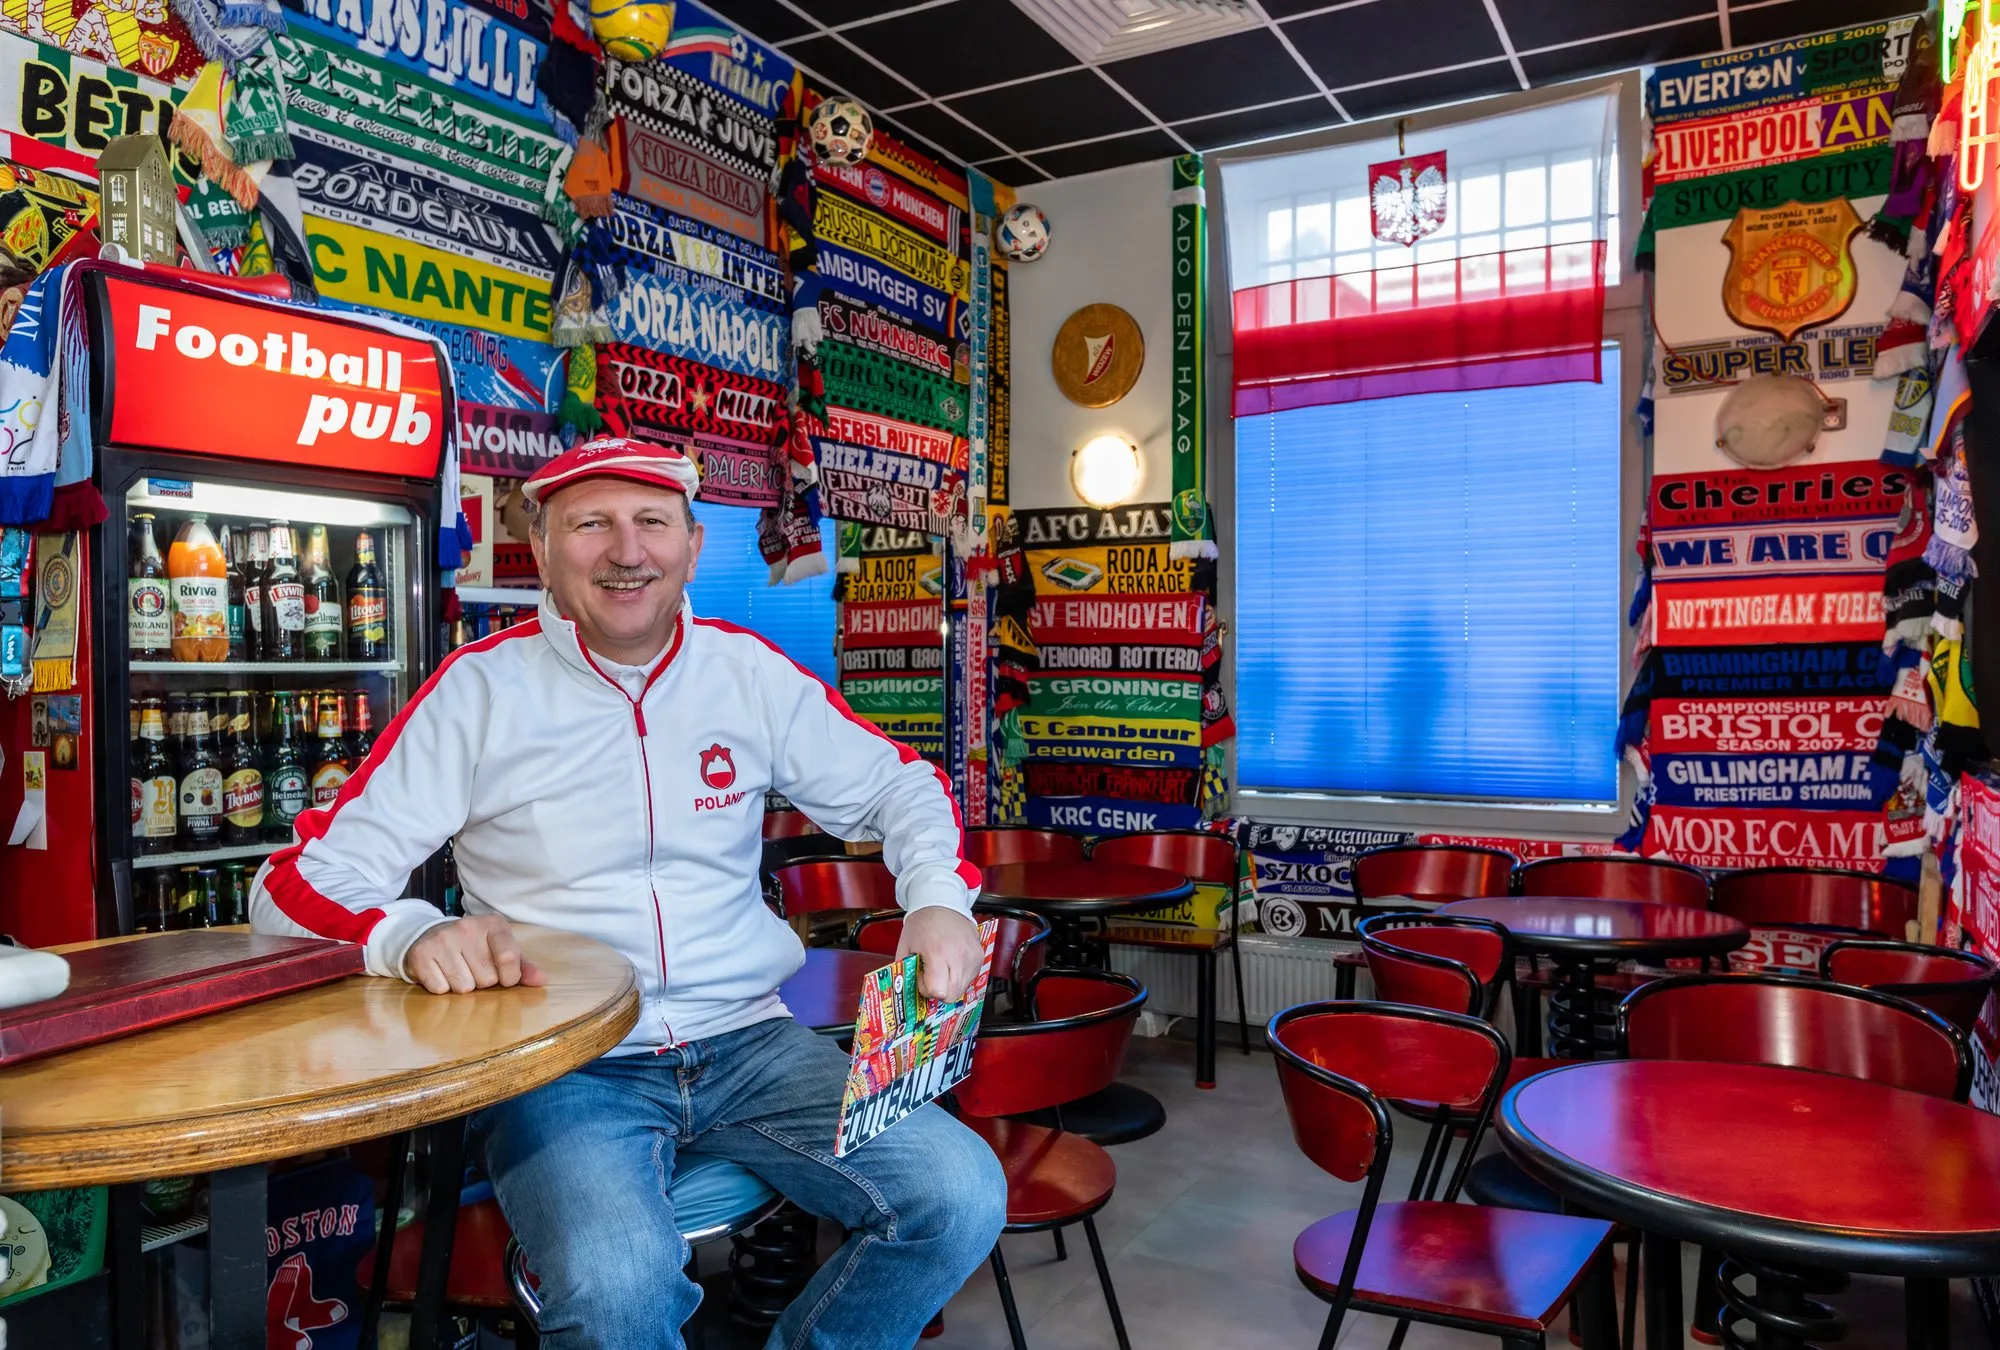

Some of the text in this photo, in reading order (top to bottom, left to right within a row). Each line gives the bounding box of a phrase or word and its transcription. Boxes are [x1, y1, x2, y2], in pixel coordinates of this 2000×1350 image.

[1701, 52, 1755, 69] EURO
[1758, 33, 1838, 58] LEAGUE
[1659, 55, 1794, 109] EVERTON
[607, 60, 698, 127] FORZA
[716, 117, 778, 167] JUVE
[1731, 106, 1775, 120] EURO
[298, 128, 393, 163] SOMMES
[413, 165, 451, 183] LES
[1665, 111, 1814, 171] LIVERPOOL
[640, 136, 752, 212] FORZA ROMA
[1673, 158, 1882, 217] STOKE CITY
[311, 203, 475, 258] NOUS ALLONS
[879, 228, 947, 282] DORTMUND
[363, 245, 552, 333] NANTE
[923, 293, 947, 322] SV
[135, 303, 402, 393] Football
[701, 301, 780, 373] NAPOLI
[849, 307, 953, 372] NÜRNBERG
[1176, 212, 1192, 455] ADO DEN HAAG
[1663, 342, 1811, 386] SUPER
[296, 392, 432, 447] pub
[717, 390, 778, 426] MILAN
[458, 421, 564, 458] LYONNA
[819, 441, 938, 489] BIELEFELD
[159, 488, 193, 498] norcool
[1658, 472, 1907, 512] Cherries
[1024, 513, 1090, 544] AFC
[1106, 548, 1160, 575] RODA
[1655, 529, 1851, 569] WE ARE
[1107, 572, 1187, 596] KERKRADE
[1065, 600, 1188, 630] EINDHOVEN
[1666, 593, 1814, 630] NOTTINGHAM
[1662, 650, 1847, 678] BIRMINGHAM
[1050, 679, 1200, 701] GRONINGE
[1681, 676, 1793, 693] PREMIER
[1661, 712, 1837, 741] BRISTOL
[1678, 700, 1831, 716] CHAMPIONSHIP
[1047, 720, 1197, 743] Cambuur
[1716, 738, 1792, 752] SEASON
[1027, 742, 1176, 762] Leeuwarden
[1666, 755, 1846, 785] GILLINGHAM
[694, 791, 746, 812] POLAND
[1694, 783, 1873, 803] PRIESTFIELD STADIUM
[1050, 805, 1158, 831] KRC GENK
[1650, 813, 1886, 860] MORECAM
[264, 1203, 360, 1258] OSTON
